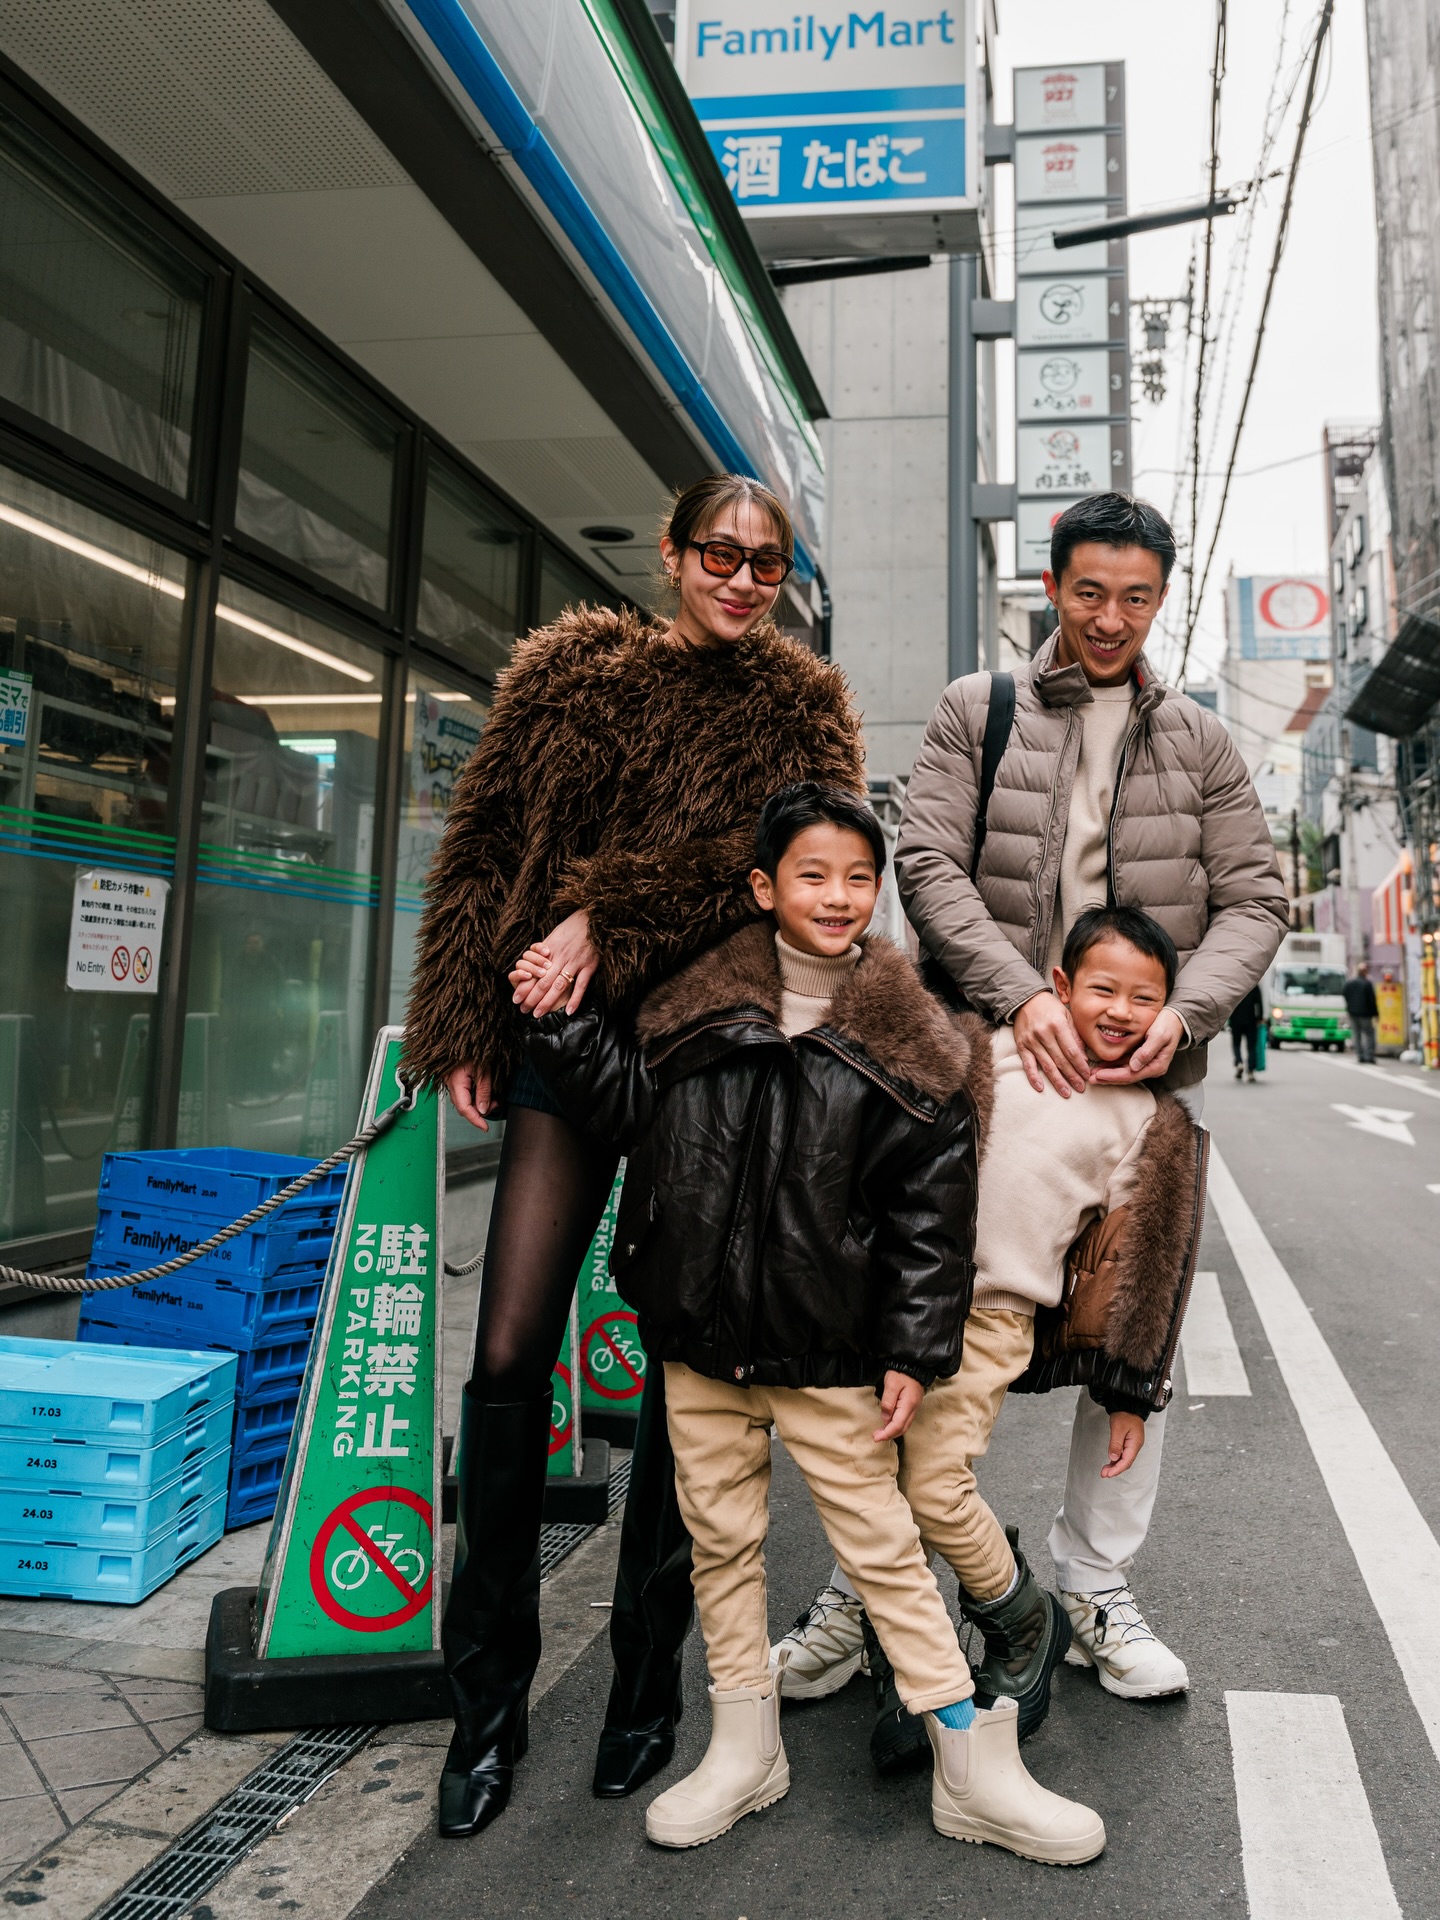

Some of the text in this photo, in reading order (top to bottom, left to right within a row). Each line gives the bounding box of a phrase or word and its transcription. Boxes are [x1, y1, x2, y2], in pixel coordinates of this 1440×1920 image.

[697, 11, 954, 62] FamilyMart
[1106, 86, 1118, 102] 7
[722, 136, 782, 198] 酒
[802, 134, 927, 190] たばこ
[1107, 157, 1120, 173] 6
[1109, 302, 1121, 317] 4
[1111, 374, 1123, 390] 3
[1112, 449, 1124, 466] 2
[99, 878, 145, 896] 防犯カメラ作動中
[76, 961, 87, 973] No
[147, 1176, 197, 1195] FamilyMart
[132, 1286, 183, 1307] FamilyMart
[332, 1223, 377, 1458] NO PARKING
[355, 1223, 430, 1457] 駐輪禁止
[31, 1406, 62, 1417] 17.03
[26, 1457, 58, 1469] 24.03
[22, 1508, 53, 1519] 24.03
[17, 1559, 49, 1571] 24.03
